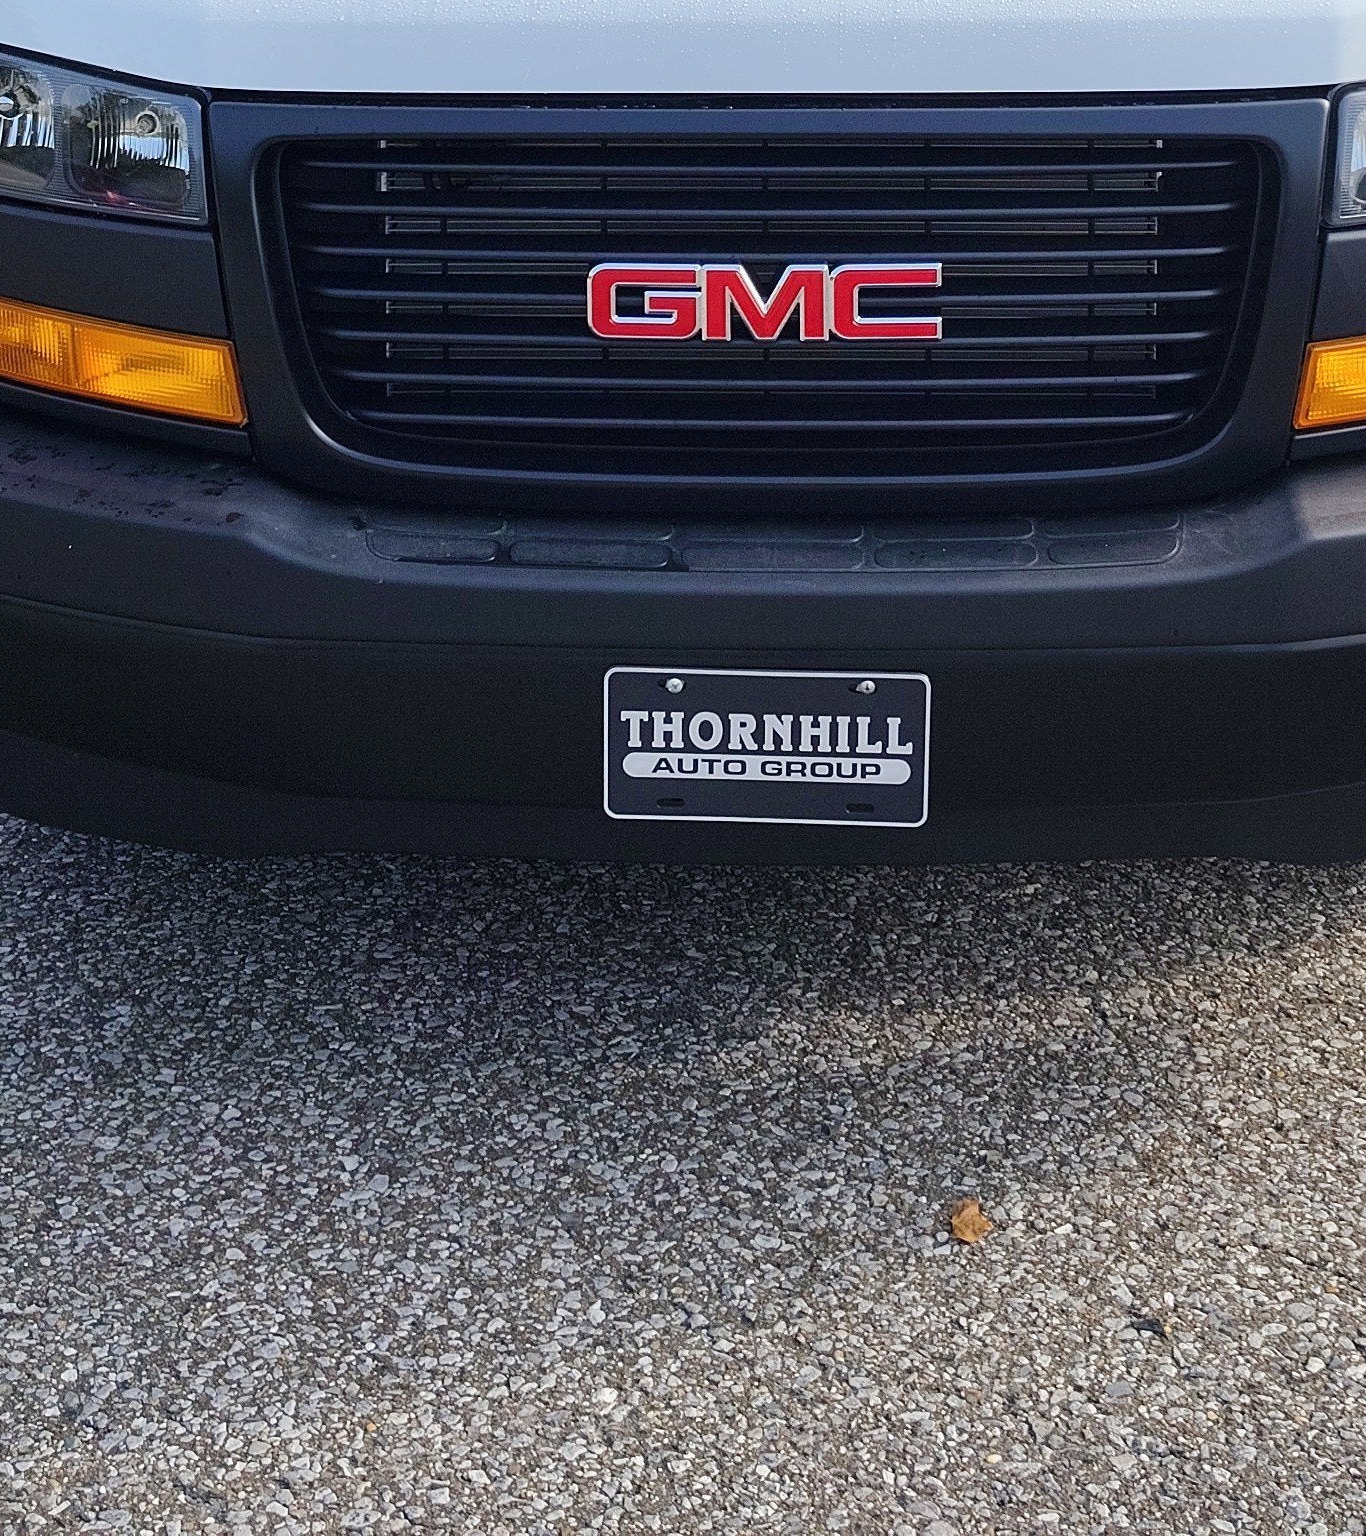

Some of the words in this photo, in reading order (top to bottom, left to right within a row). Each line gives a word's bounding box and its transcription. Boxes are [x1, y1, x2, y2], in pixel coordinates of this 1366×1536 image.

[587, 262, 943, 342] GMC
[620, 710, 914, 755] THORNHILL
[651, 756, 747, 776] AUTO
[760, 759, 883, 779] GROUP
